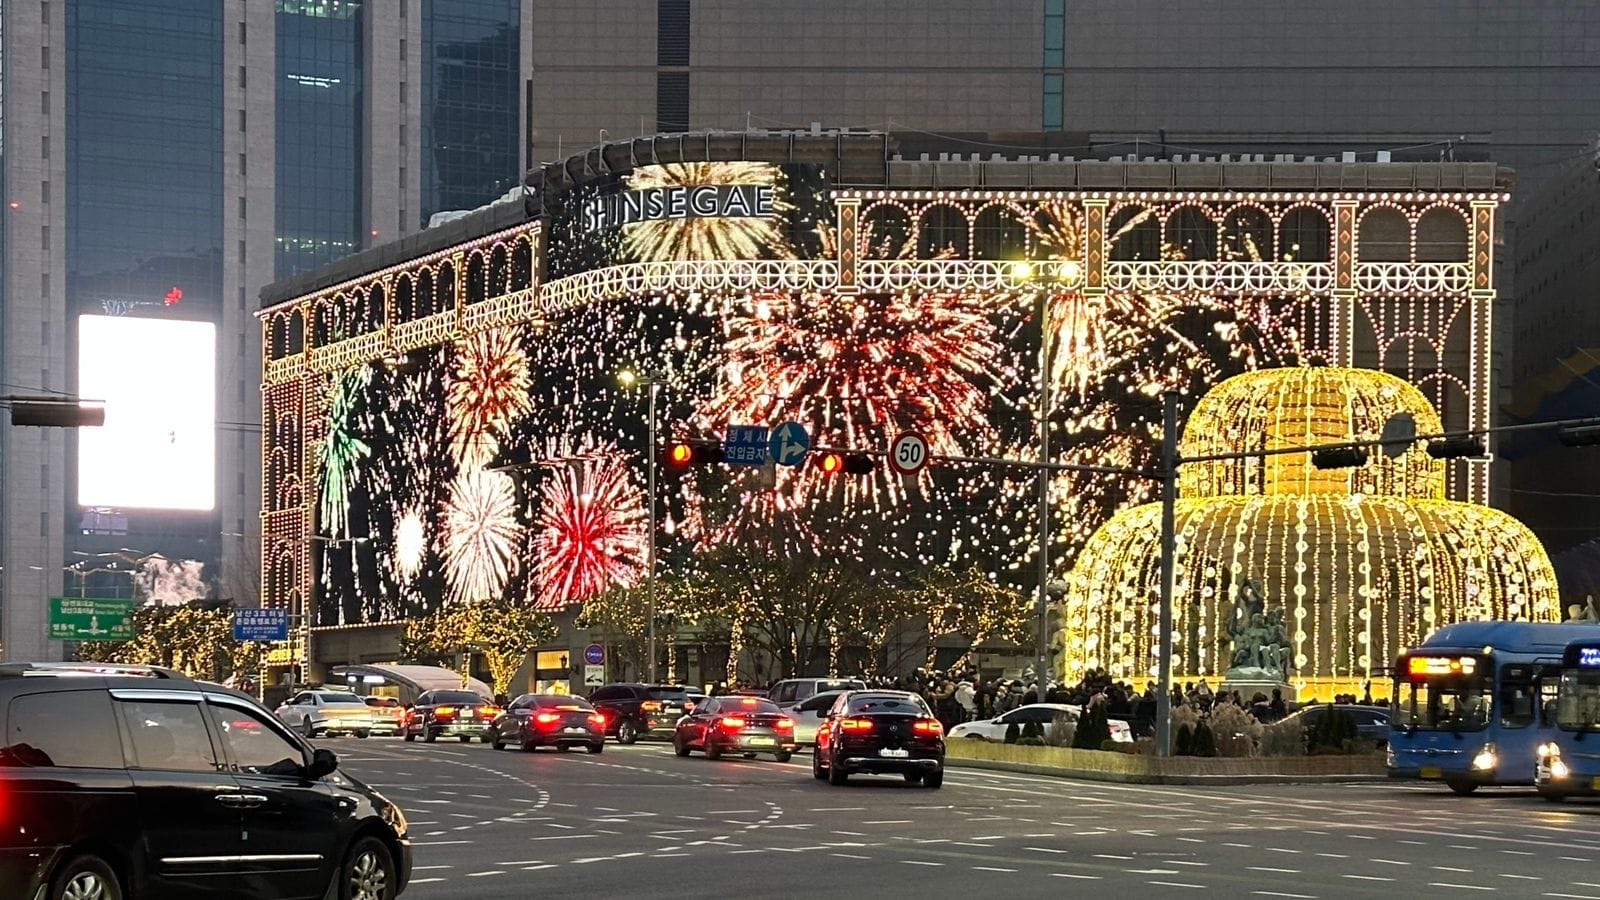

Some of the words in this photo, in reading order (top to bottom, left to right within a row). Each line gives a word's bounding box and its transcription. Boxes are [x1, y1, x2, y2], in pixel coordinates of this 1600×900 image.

[583, 184, 775, 233] SHINSEGAE
[726, 445, 765, 461] 진입금지
[899, 442, 921, 463] 50
